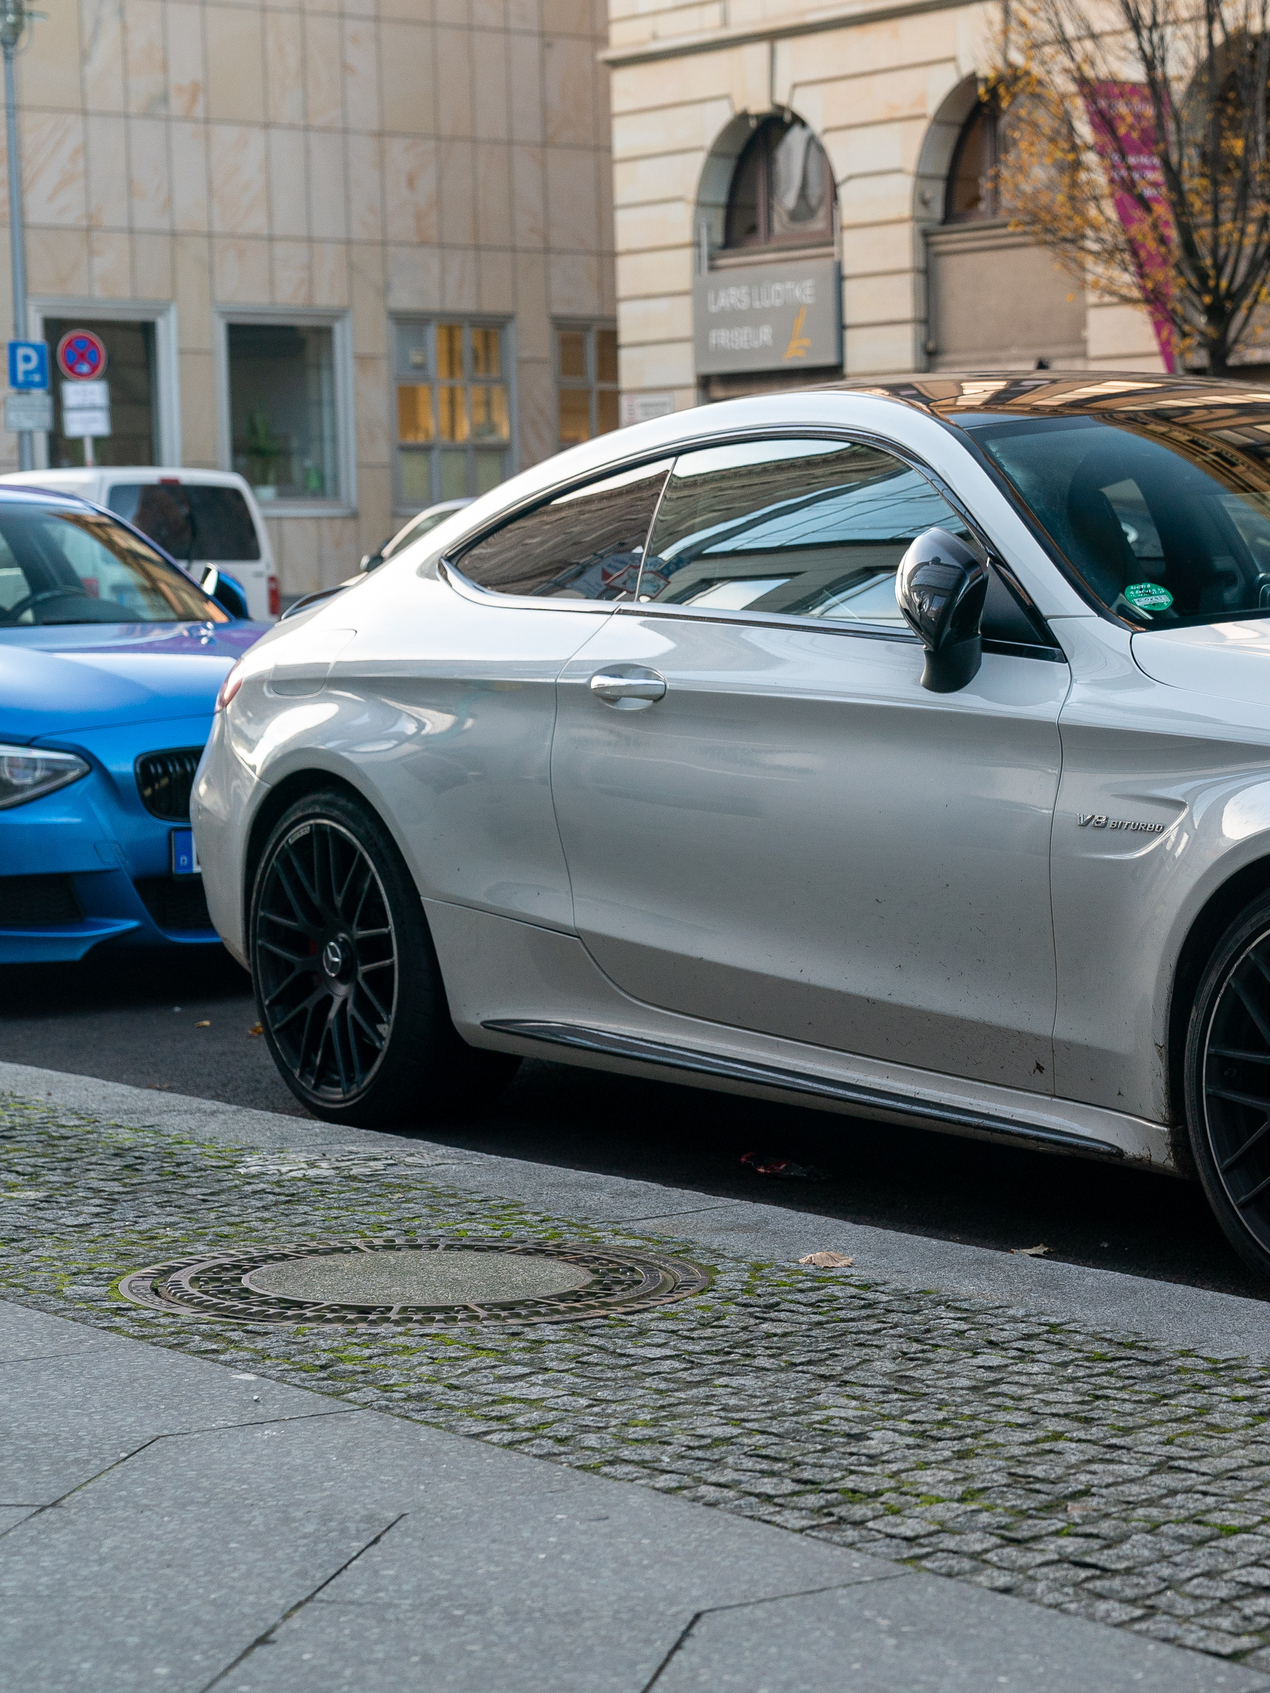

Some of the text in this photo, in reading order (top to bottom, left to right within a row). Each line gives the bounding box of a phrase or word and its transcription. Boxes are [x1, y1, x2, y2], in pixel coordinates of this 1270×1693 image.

[708, 285, 750, 313] LARS
[708, 324, 772, 351] FRISEUR
[16, 346, 38, 384] P
[1076, 813, 1165, 833] V8 BITURBO
